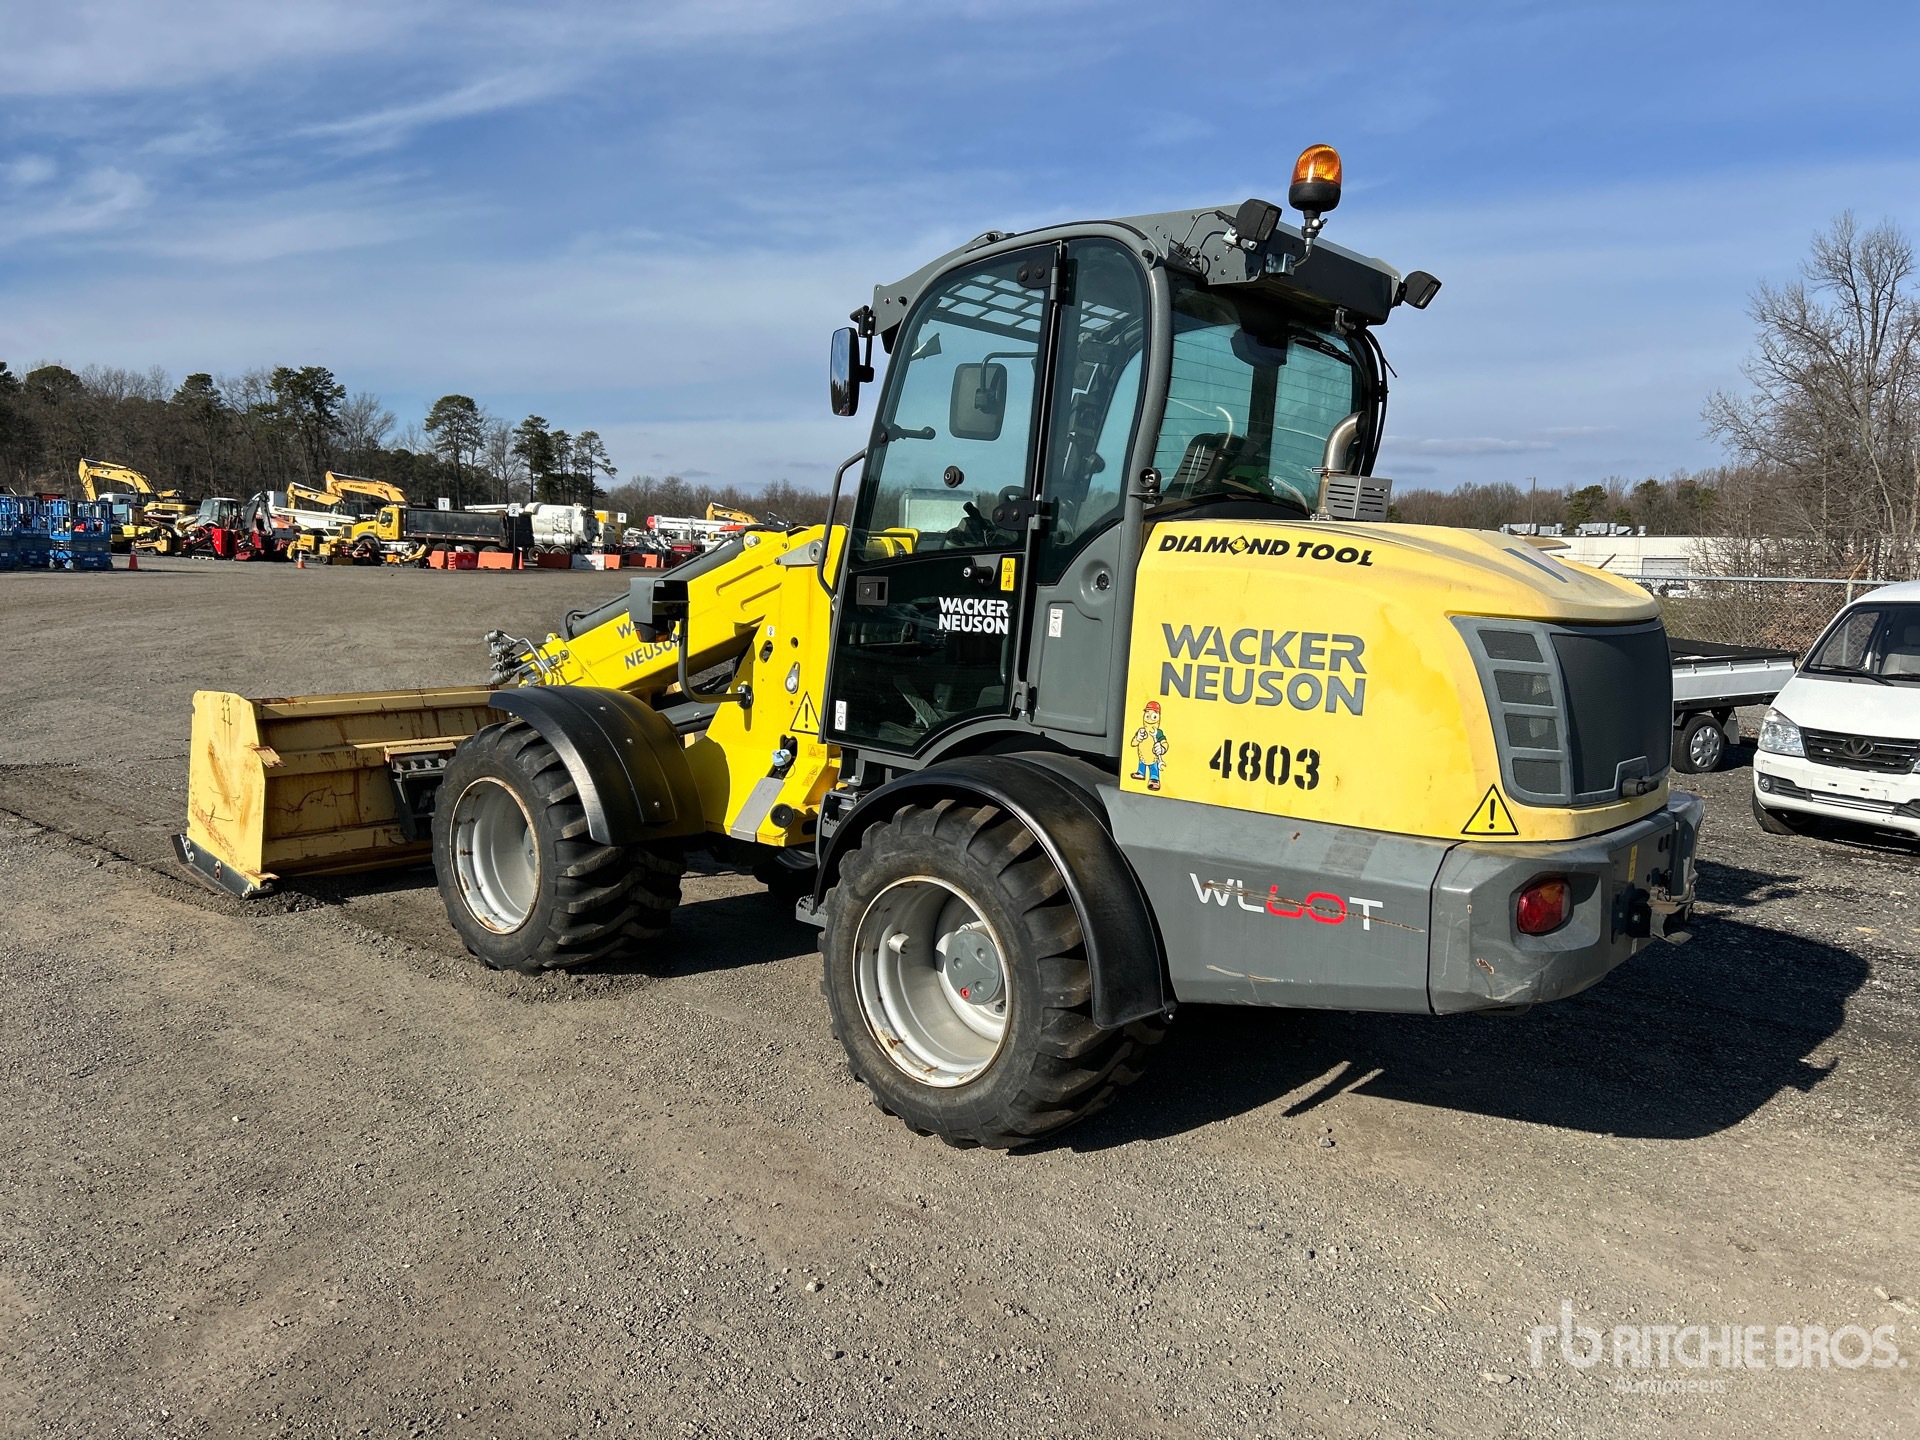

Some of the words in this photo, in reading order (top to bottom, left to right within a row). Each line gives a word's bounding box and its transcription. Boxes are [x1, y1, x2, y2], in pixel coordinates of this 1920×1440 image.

[1296, 541, 1373, 566] TOOL
[938, 613, 1009, 635] NEUSON
[939, 597, 1009, 618] WACKER
[1161, 623, 1368, 674] WACKER
[1160, 661, 1367, 716] NEUSON
[1209, 739, 1321, 790] 4803
